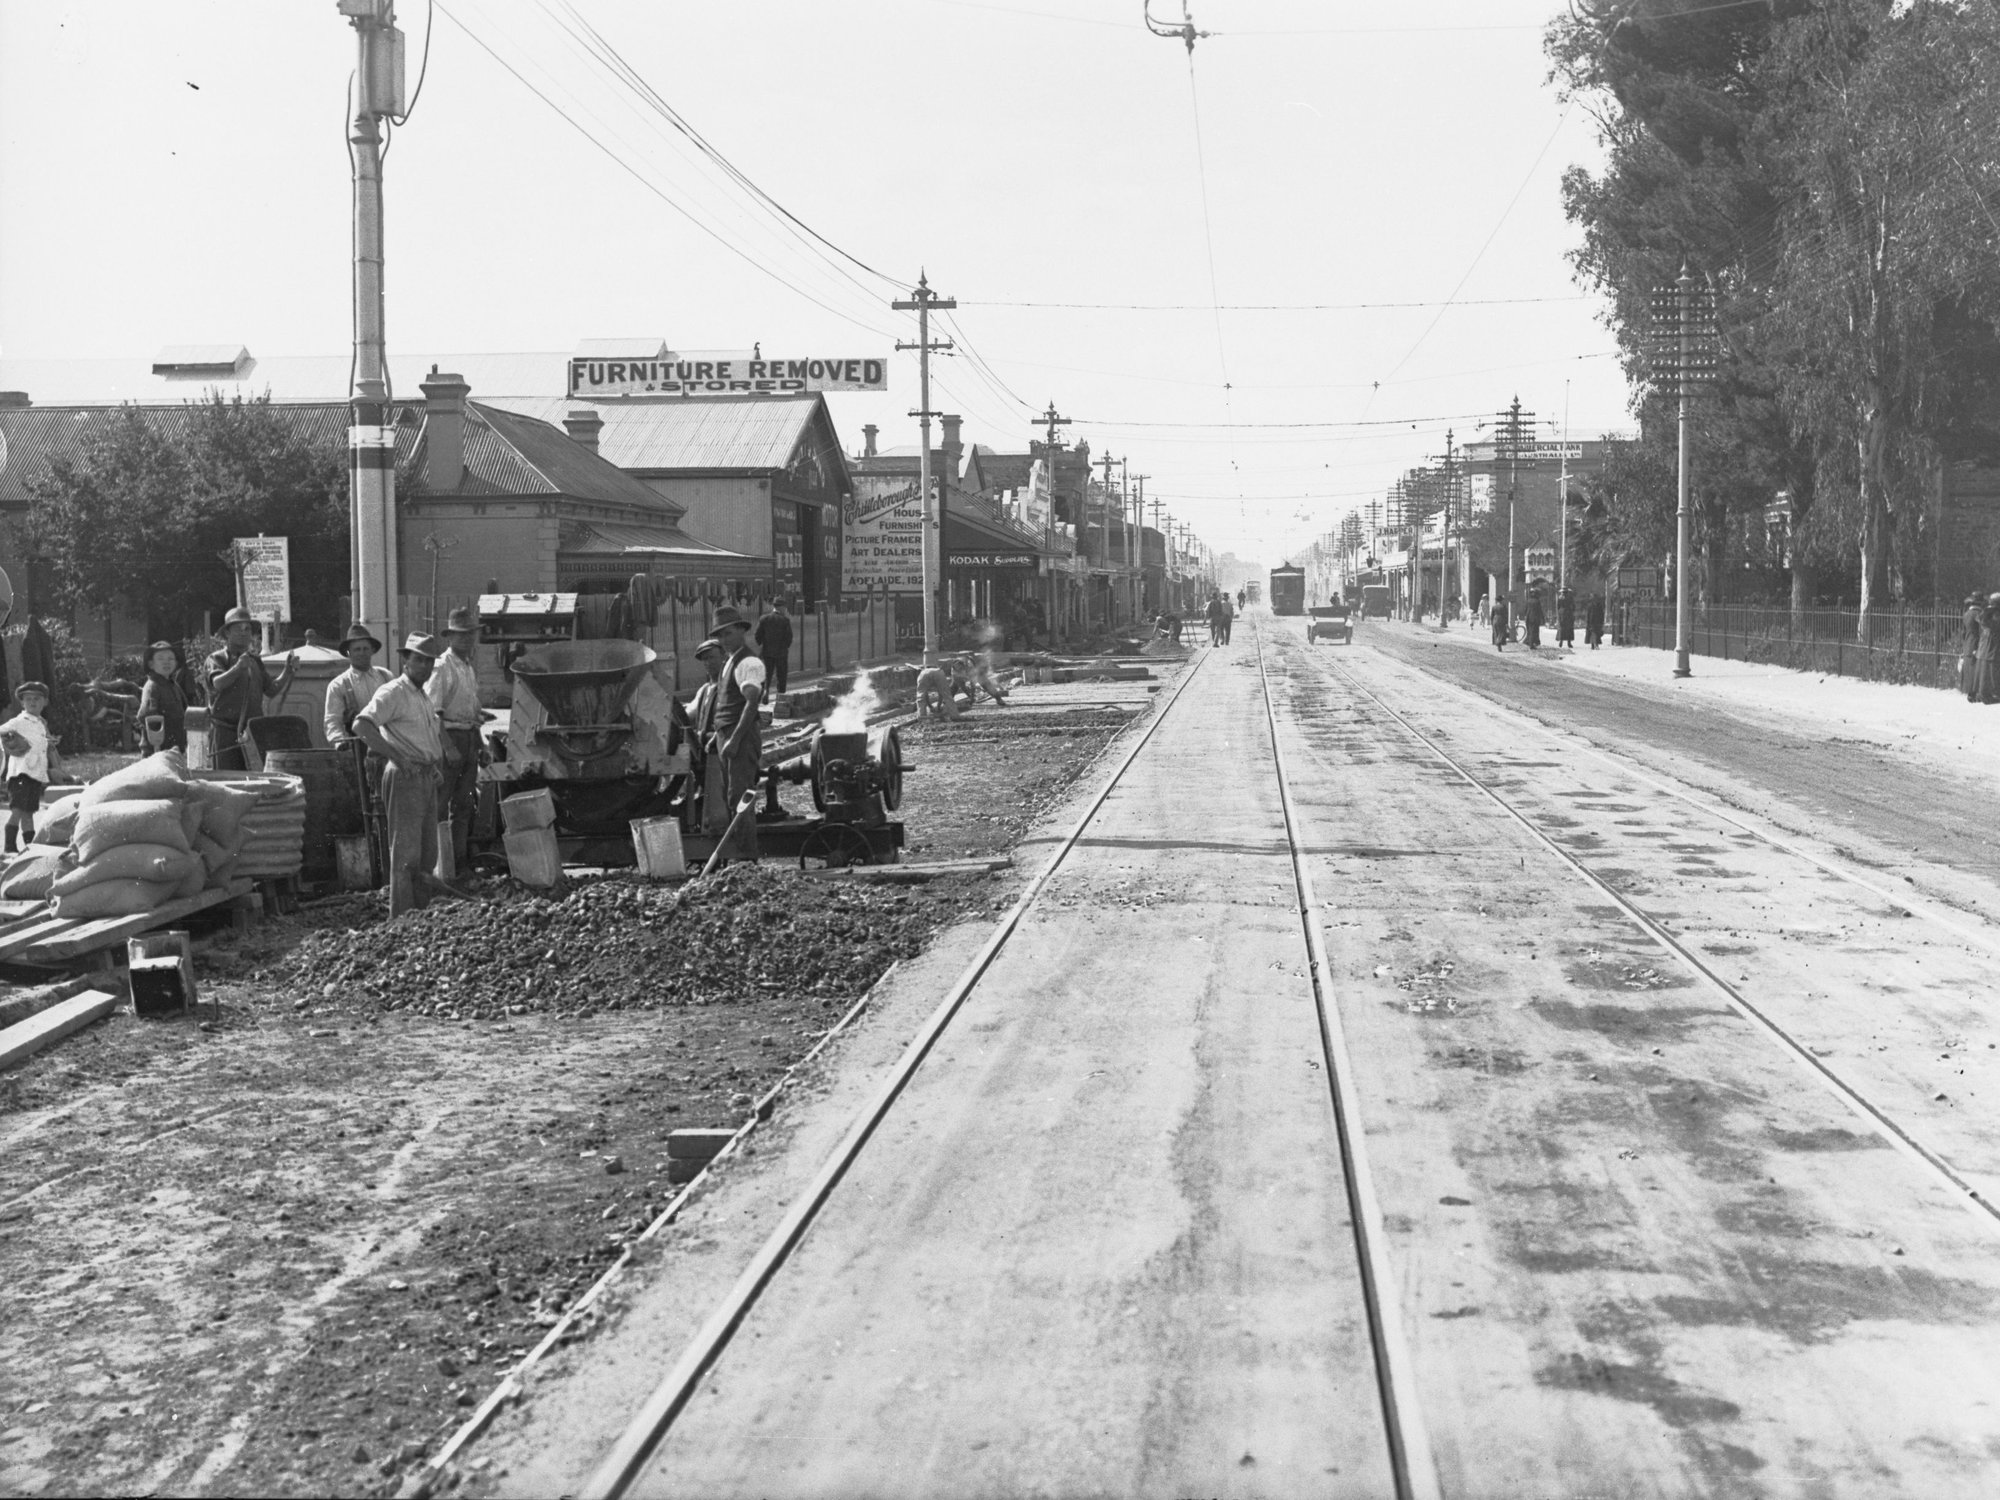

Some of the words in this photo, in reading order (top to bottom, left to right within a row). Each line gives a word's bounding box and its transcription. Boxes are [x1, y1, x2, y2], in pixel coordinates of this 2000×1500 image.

[572, 360, 732, 390] FURNITURE
[749, 359, 883, 384] REMOVED
[645, 383, 656, 391] &
[661, 380, 804, 391] STORED
[894, 509, 922, 518] HOUS
[879, 521, 939, 530] FURNISHS
[845, 535, 880, 544] PICTURE
[851, 547, 869, 557] ART
[873, 547, 922, 557] DEALERS
[949, 555, 989, 565] KODAK
